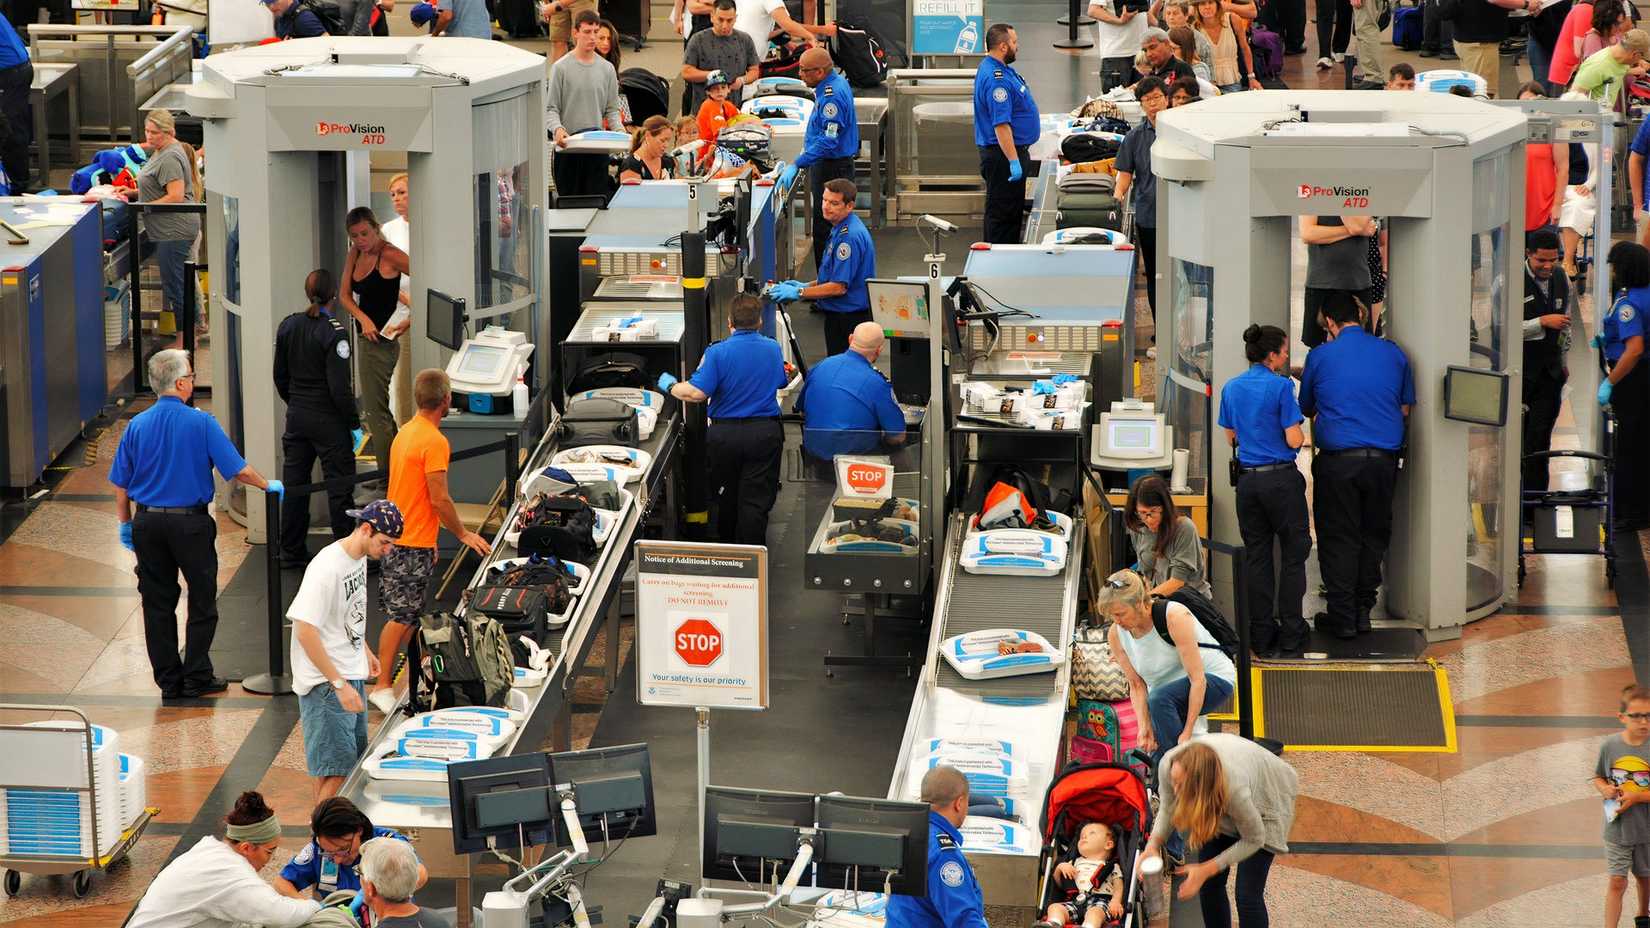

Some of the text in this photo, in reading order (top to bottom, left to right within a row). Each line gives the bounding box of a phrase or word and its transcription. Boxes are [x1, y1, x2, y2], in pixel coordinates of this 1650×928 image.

[331, 123, 385, 134] ProVision
[361, 135, 385, 145] ATD
[689, 185, 696, 200] 5
[1313, 185, 1369, 197] ProVision
[1343, 198, 1369, 208] ATD
[931, 263, 938, 279] 6
[852, 470, 882, 481] STOP
[644, 555, 744, 568] Notice of Additional Screening
[677, 633, 720, 651] STOP
[652, 673, 669, 681] Your
[671, 674, 693, 684] safety
[695, 675, 702, 683] is
[717, 676, 746, 686] priority
